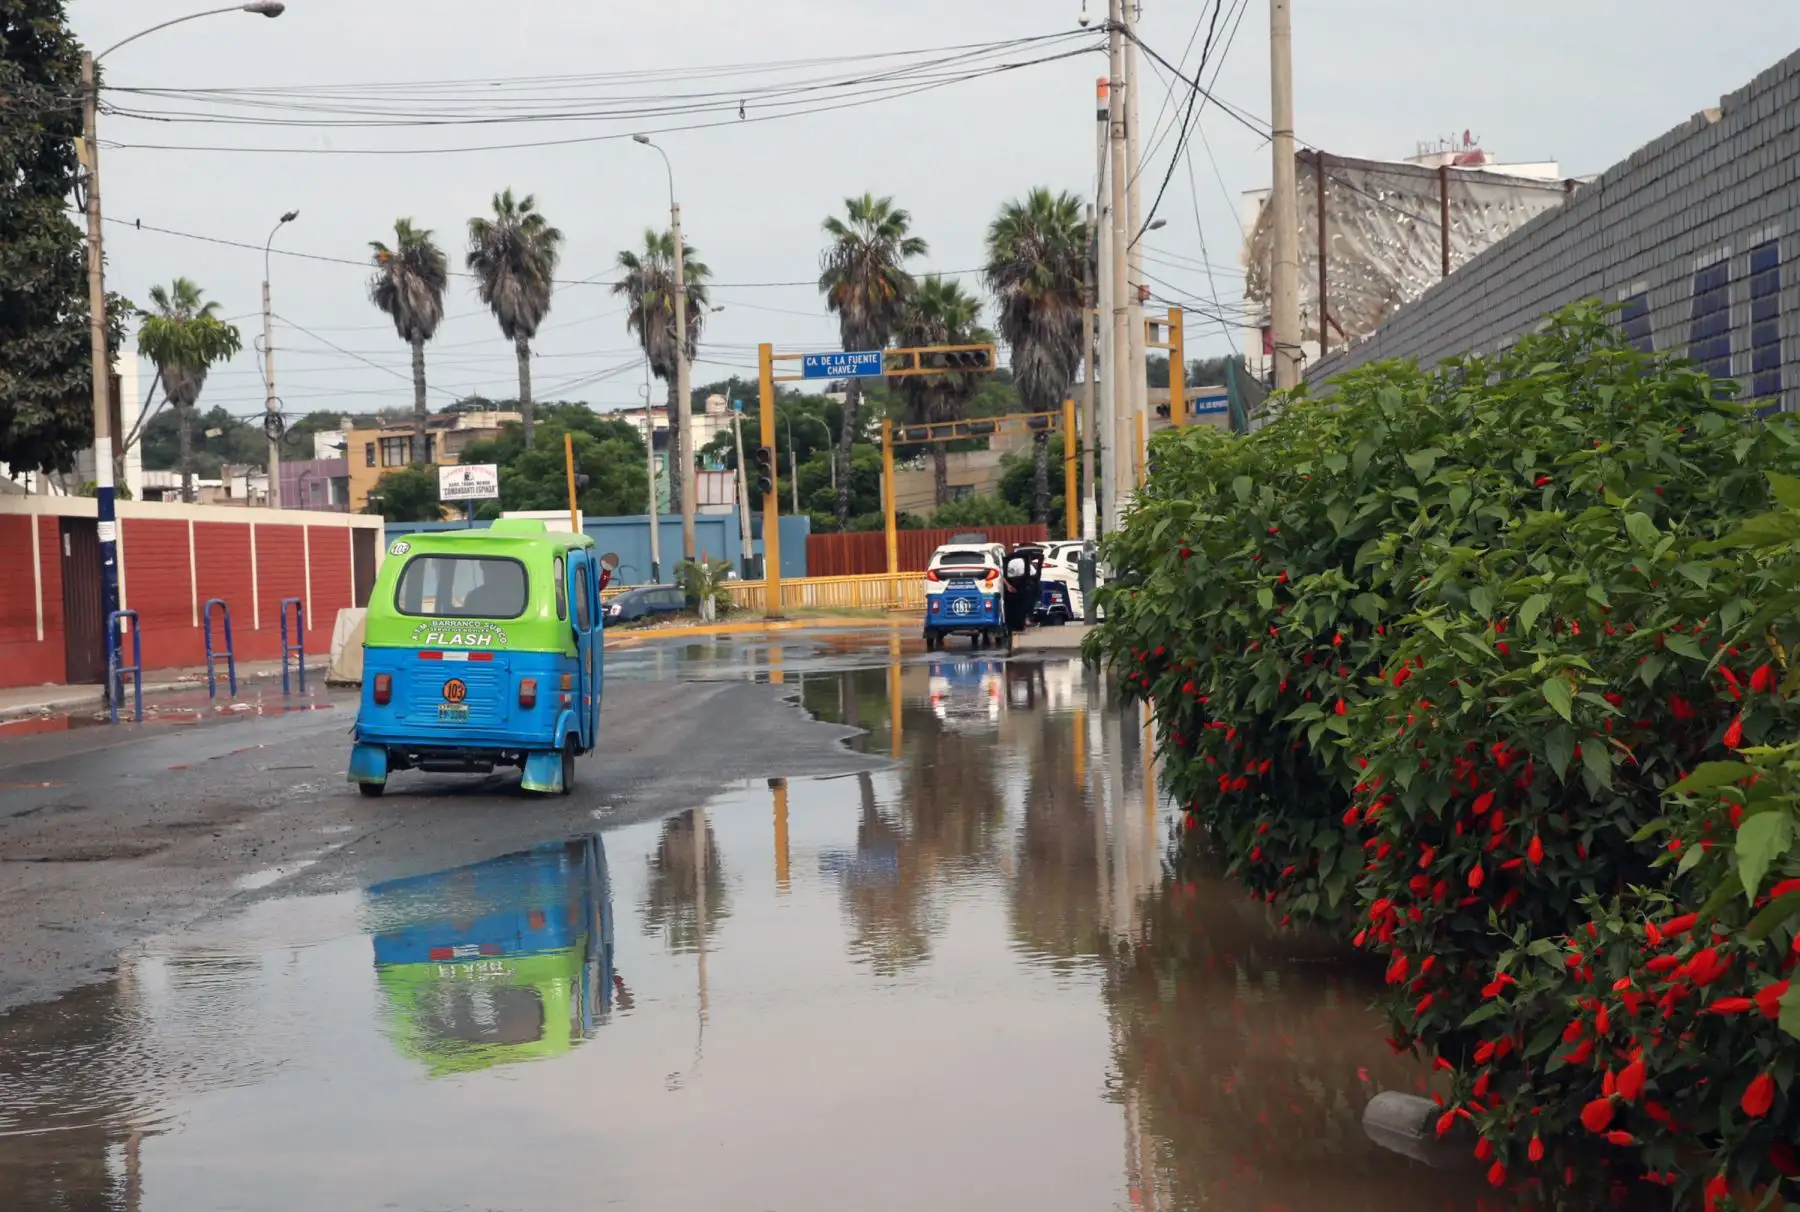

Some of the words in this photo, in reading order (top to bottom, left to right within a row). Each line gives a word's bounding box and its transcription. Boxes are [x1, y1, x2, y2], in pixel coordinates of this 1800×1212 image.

[821, 356, 831, 366] DE
[835, 356, 845, 365] LA
[848, 354, 878, 364] FUENTE
[827, 365, 857, 375] CHAVEZ
[425, 633, 492, 646] FLASH
[484, 622, 507, 644] SURCO
[447, 683, 464, 699] 103
